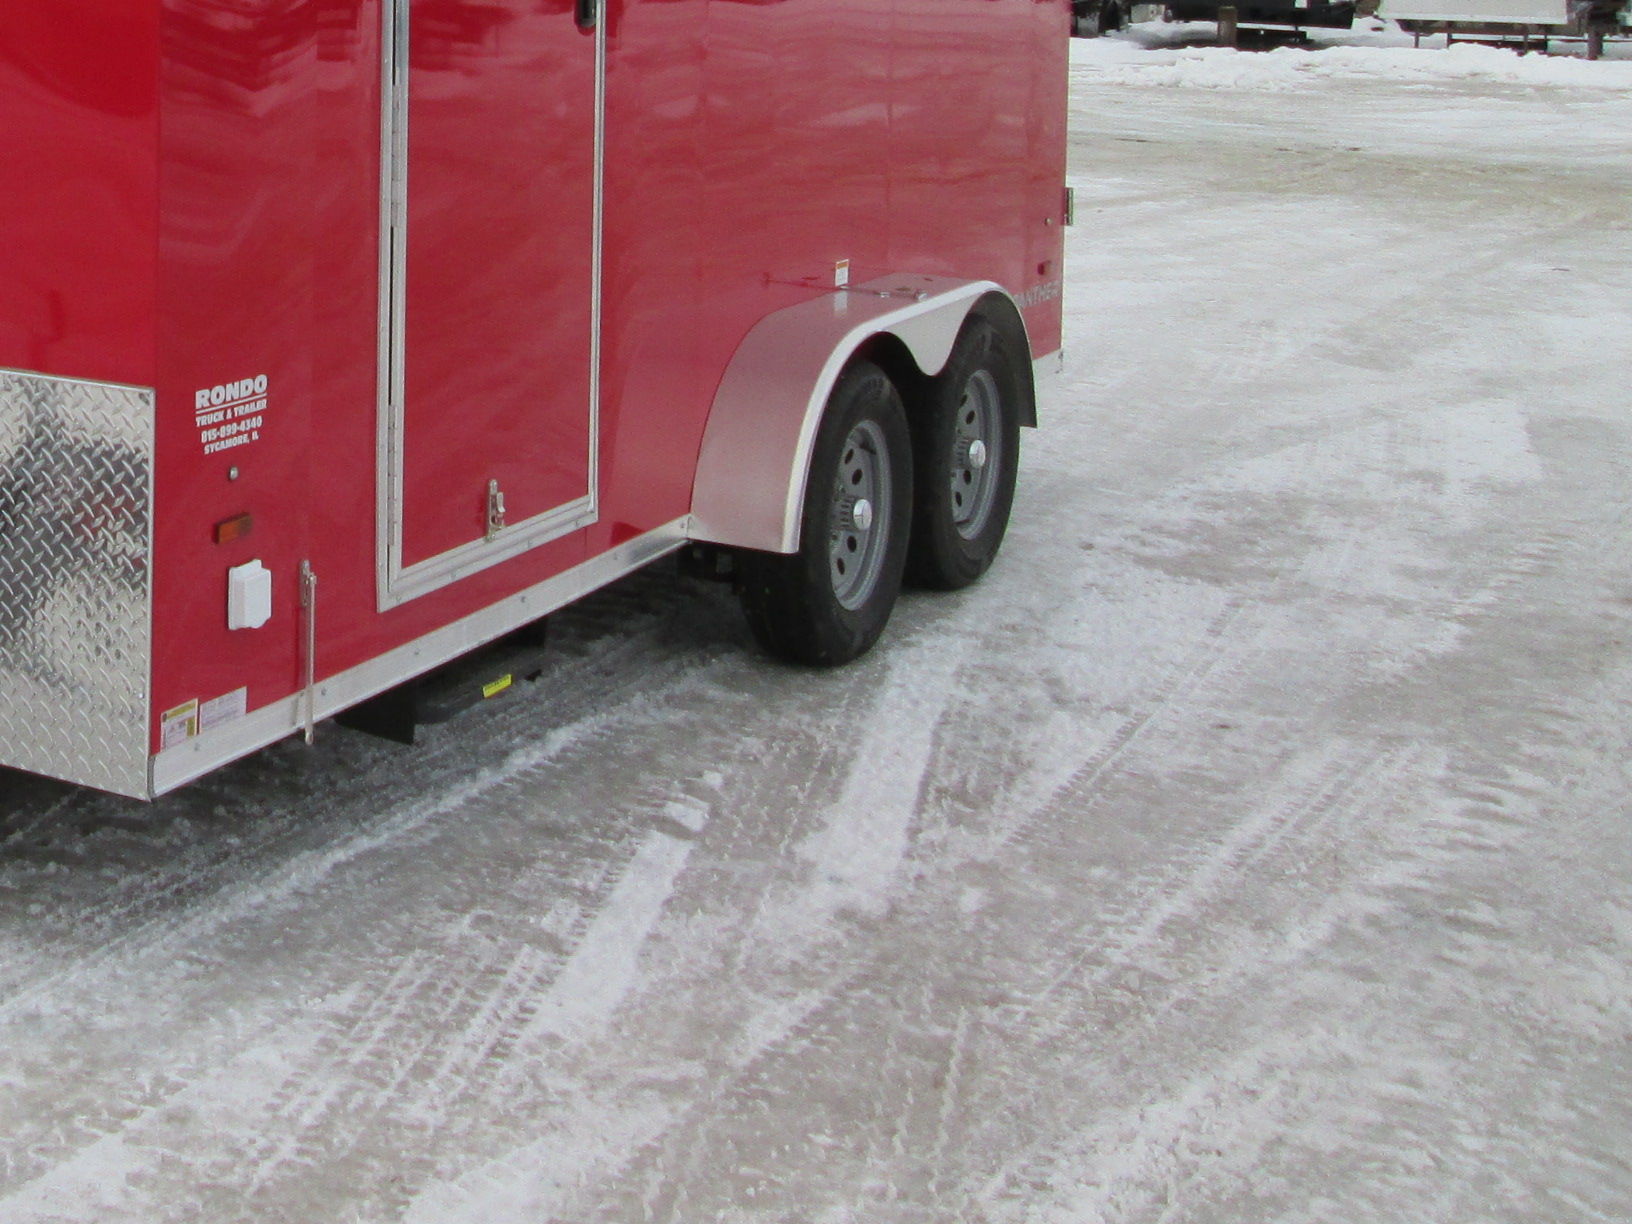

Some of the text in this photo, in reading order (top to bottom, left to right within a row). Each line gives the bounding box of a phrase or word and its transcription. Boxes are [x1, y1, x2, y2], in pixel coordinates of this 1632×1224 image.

[195, 374, 268, 410] RONDO
[195, 410, 225, 427] TRUCK
[234, 399, 267, 417] TRAILER
[201, 416, 263, 443] 815-899-4340
[251, 431, 259, 441] IL
